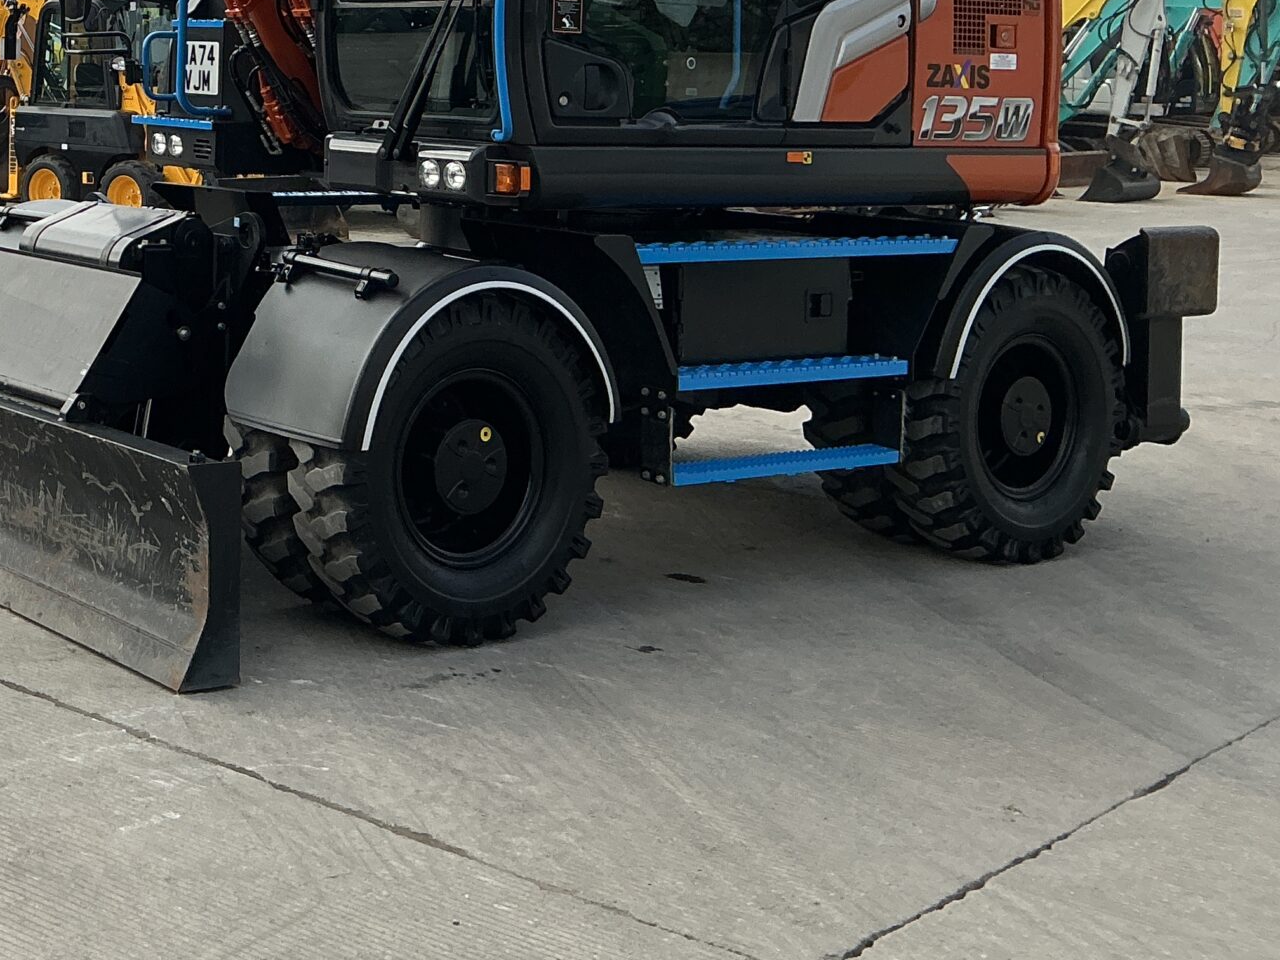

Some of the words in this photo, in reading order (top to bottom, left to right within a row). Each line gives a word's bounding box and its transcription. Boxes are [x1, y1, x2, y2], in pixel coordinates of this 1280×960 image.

[186, 44, 215, 66] A74
[185, 69, 211, 91] VJM
[926, 59, 990, 90] ZAXIS
[918, 95, 1034, 141] 135W
